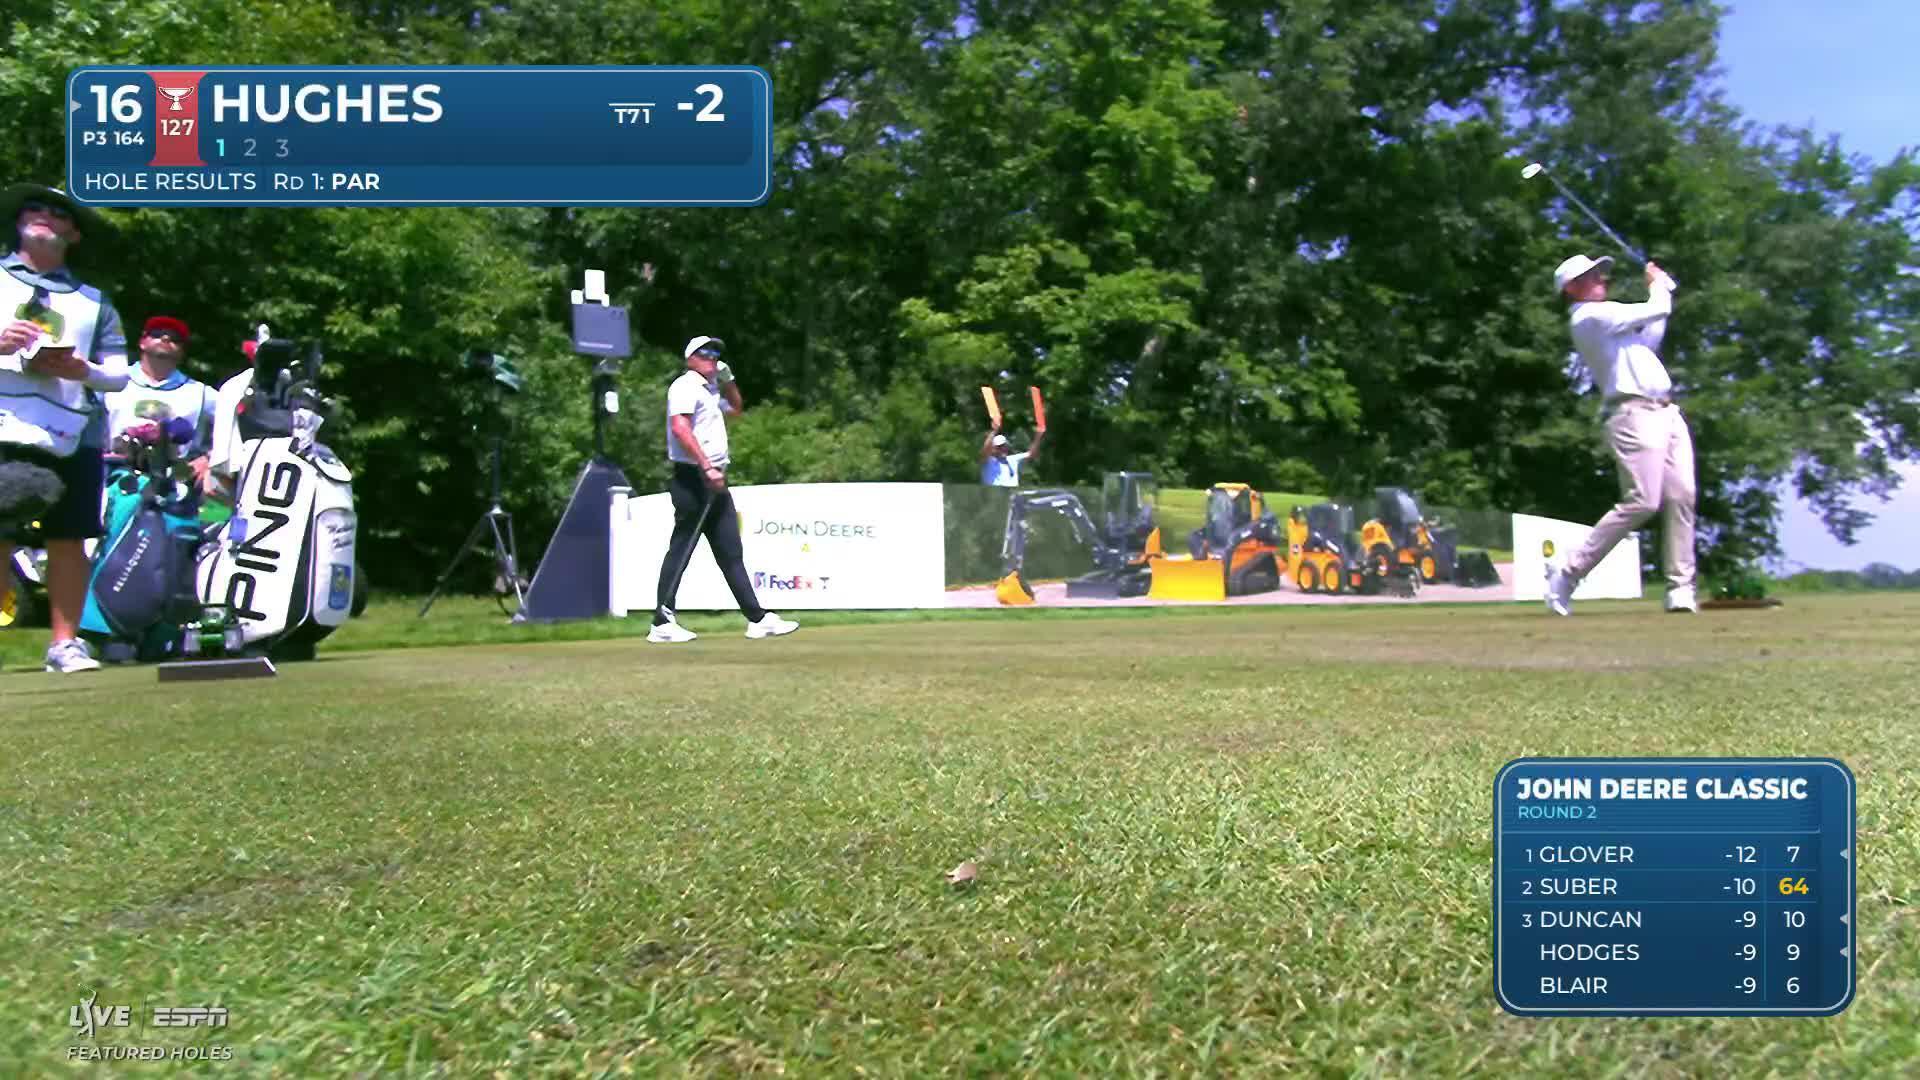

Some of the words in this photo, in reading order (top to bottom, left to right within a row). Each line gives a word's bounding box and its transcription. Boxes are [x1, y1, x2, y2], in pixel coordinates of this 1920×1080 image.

[753, 519, 808, 536] JOHN
[813, 520, 877, 538] DEERE
[225, 461, 301, 622] PING
[769, 574, 813, 591] FedEx
